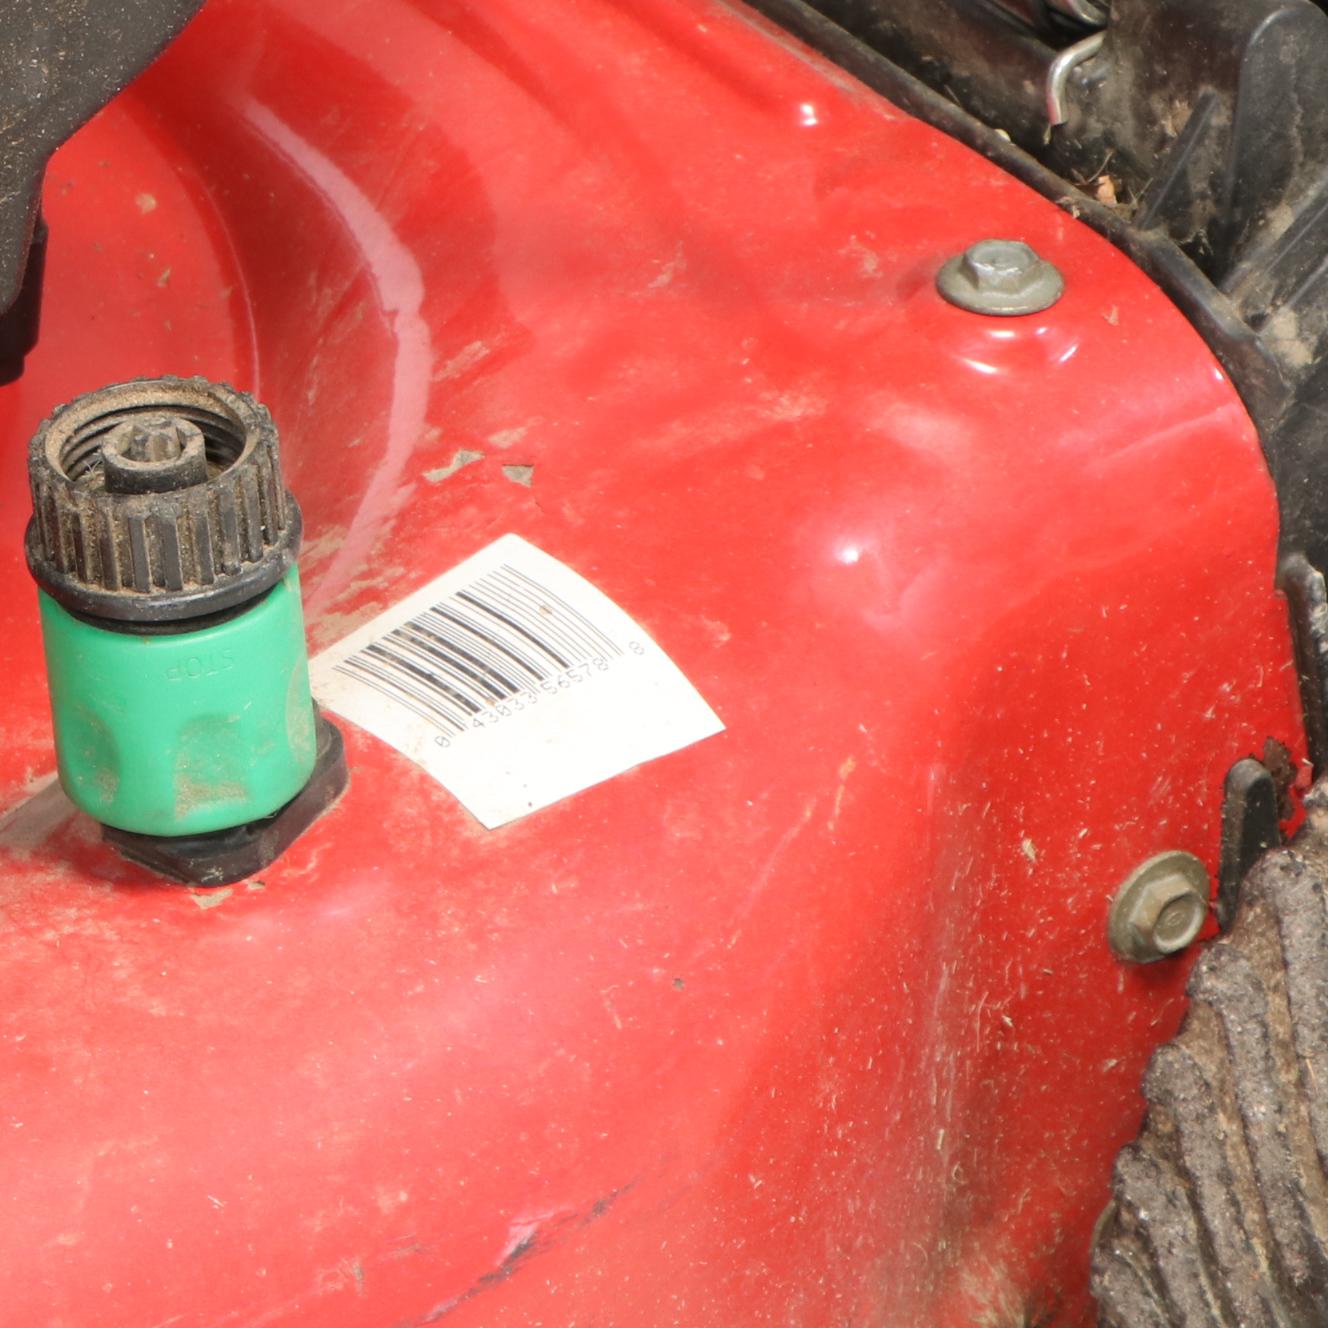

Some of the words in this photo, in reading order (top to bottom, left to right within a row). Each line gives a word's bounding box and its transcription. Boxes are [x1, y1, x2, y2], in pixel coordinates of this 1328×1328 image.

[472, 691, 538, 728] 43033
[540, 657, 609, 695] 56578
[628, 640, 645, 656] 8
